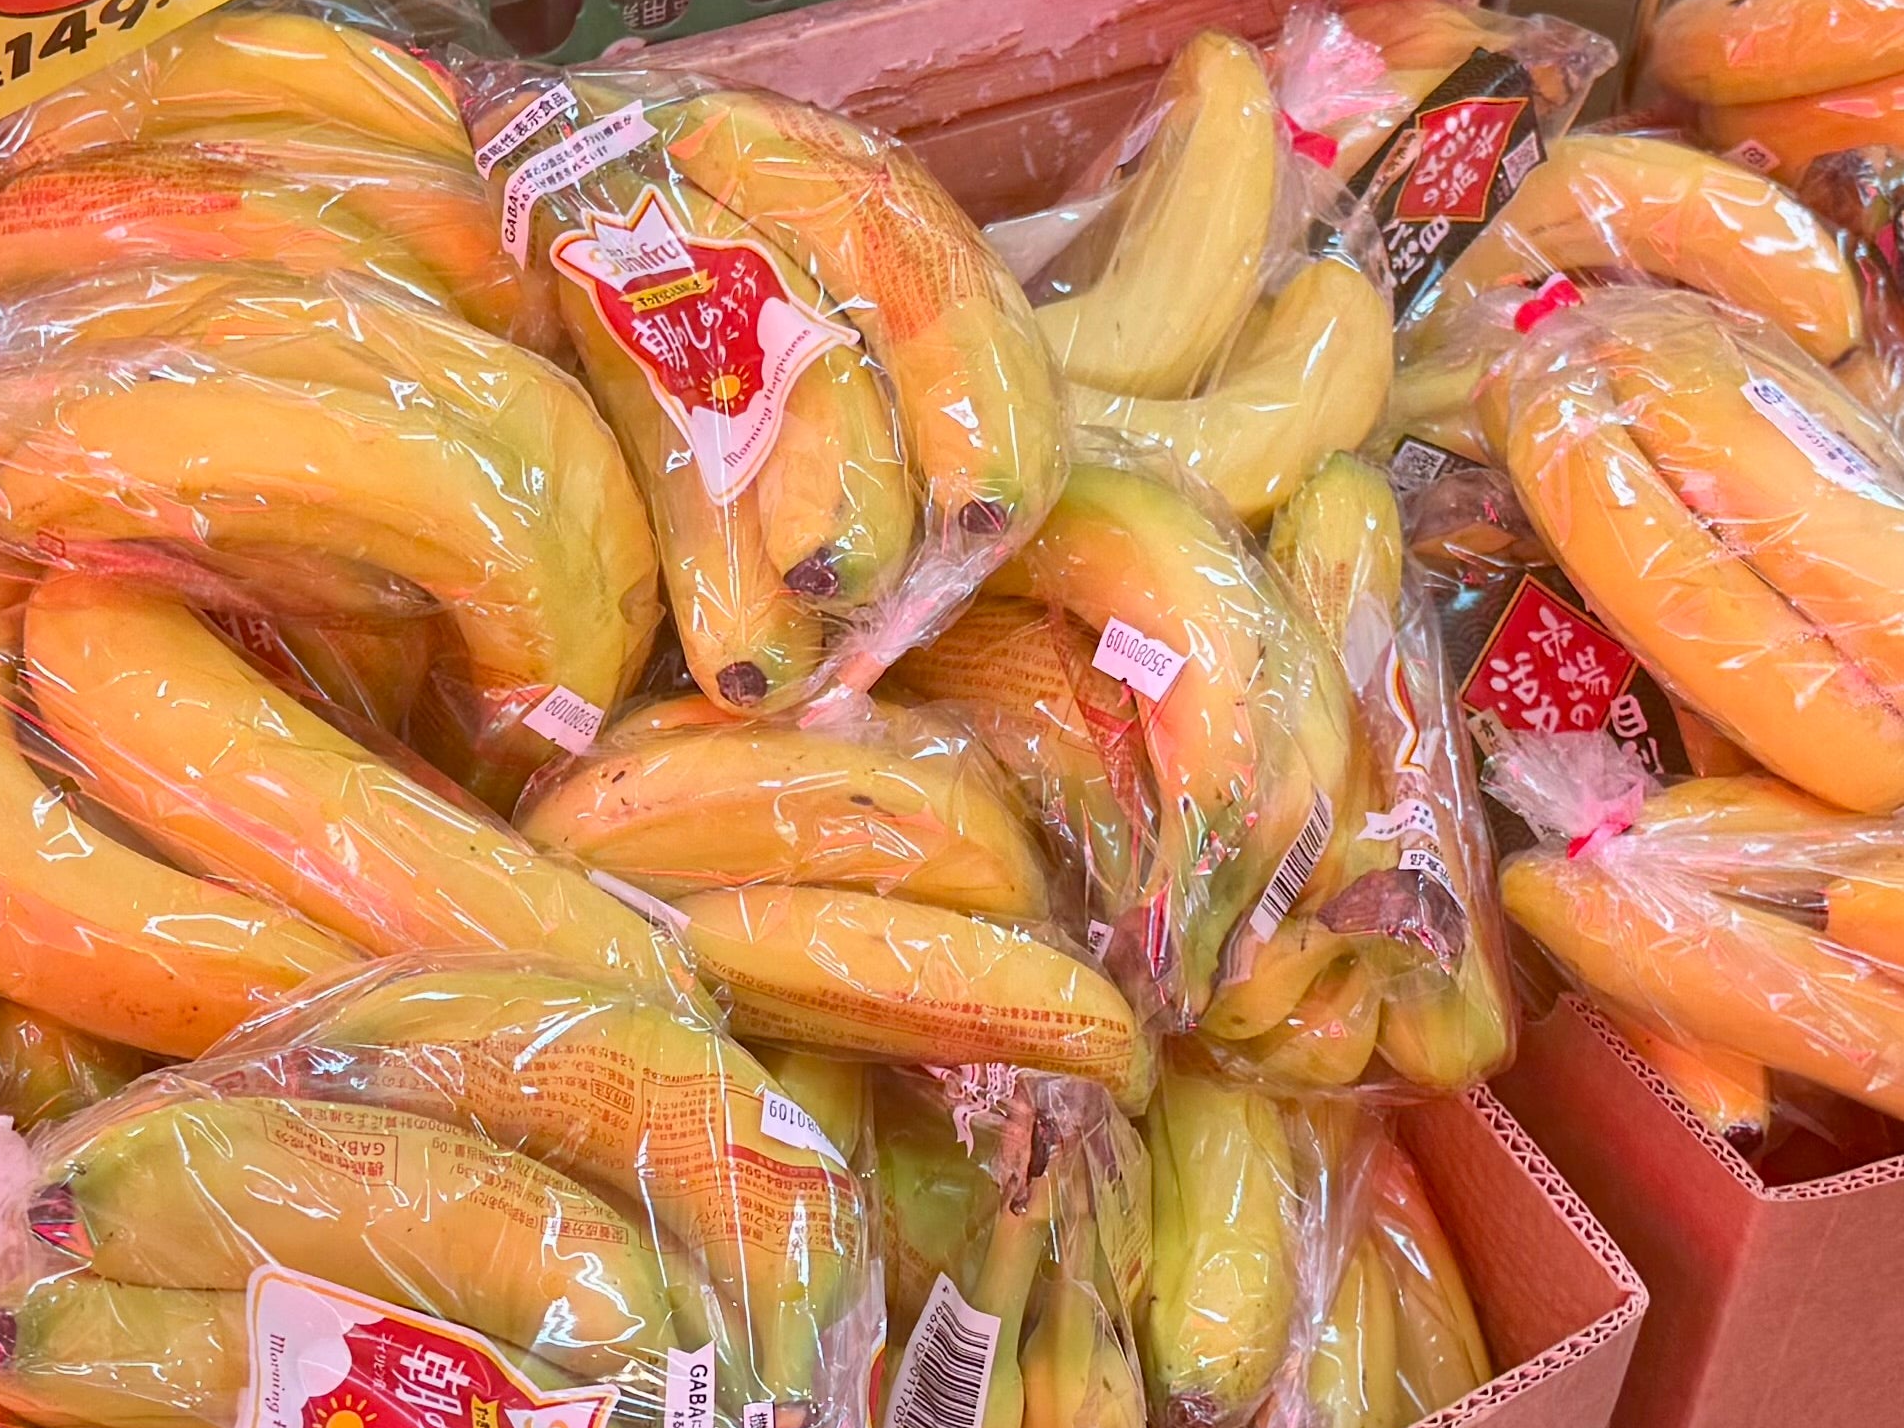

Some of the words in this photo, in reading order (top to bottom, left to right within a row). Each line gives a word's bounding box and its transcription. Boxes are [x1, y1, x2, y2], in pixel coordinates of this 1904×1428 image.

[723, 404, 773, 469] Morning
[1106, 627, 1174, 679] 35080109
[544, 692, 595, 738] 35080109
[261, 1333, 287, 1420] Morning
